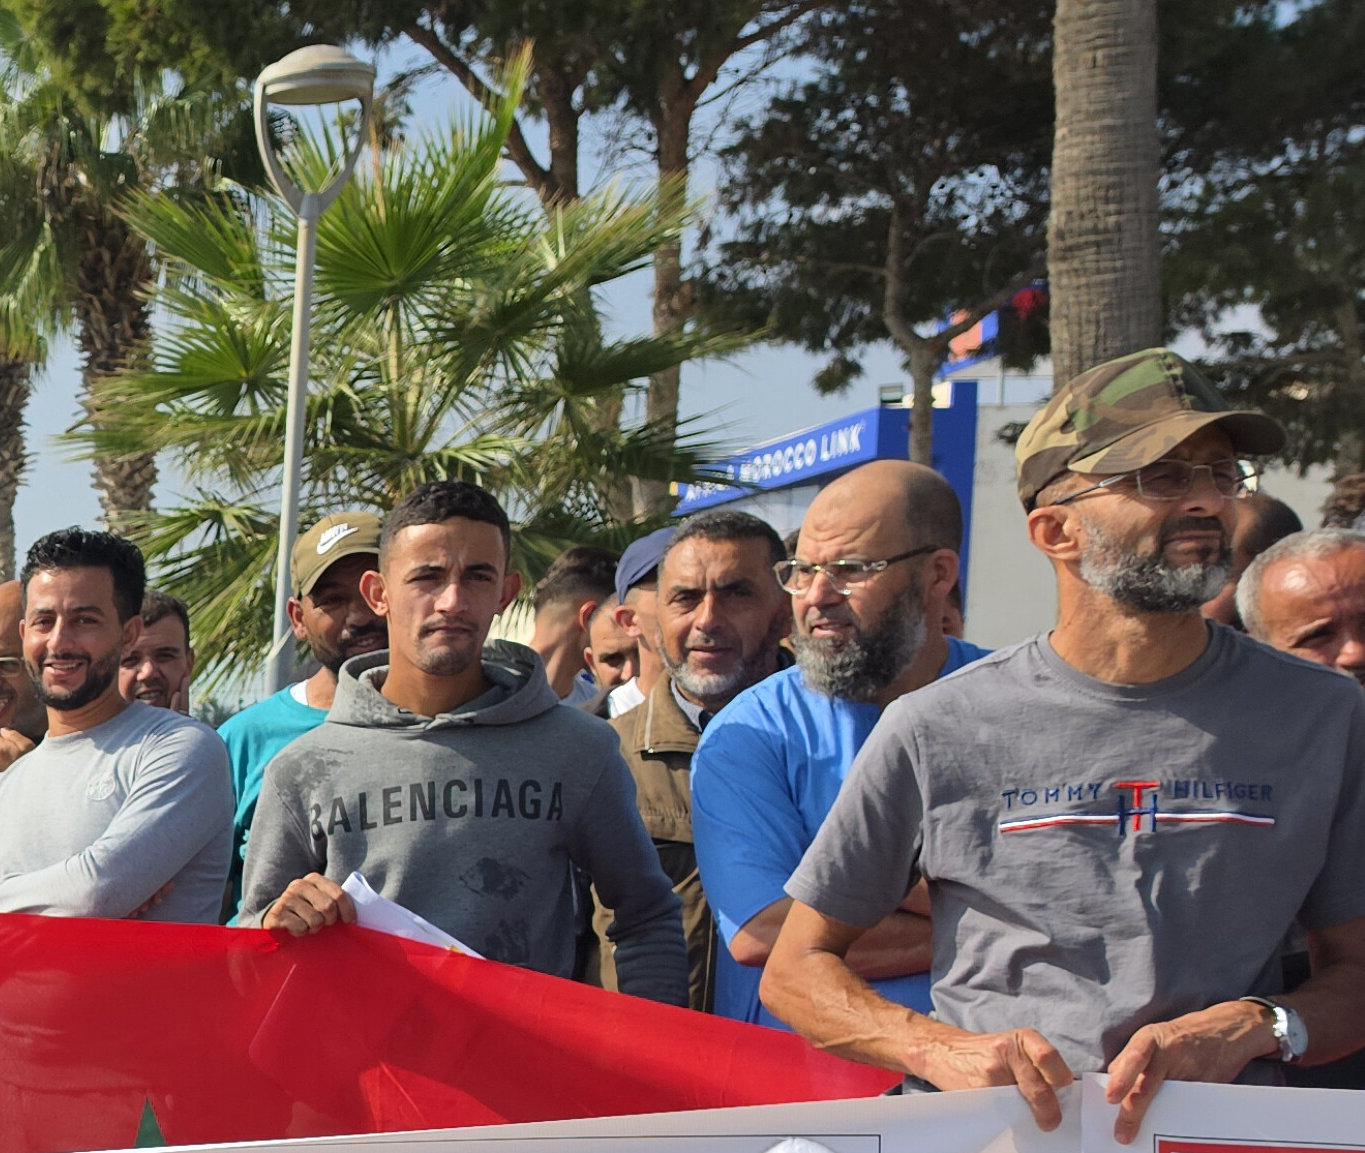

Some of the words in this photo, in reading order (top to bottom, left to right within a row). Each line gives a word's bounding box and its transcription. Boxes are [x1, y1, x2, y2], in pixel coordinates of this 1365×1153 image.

[820, 423, 862, 462] LINK
[310, 778, 564, 842] BALENCIAGA
[1002, 782, 1101, 809] TOMMY
[1173, 779, 1273, 801] HILFIGER
